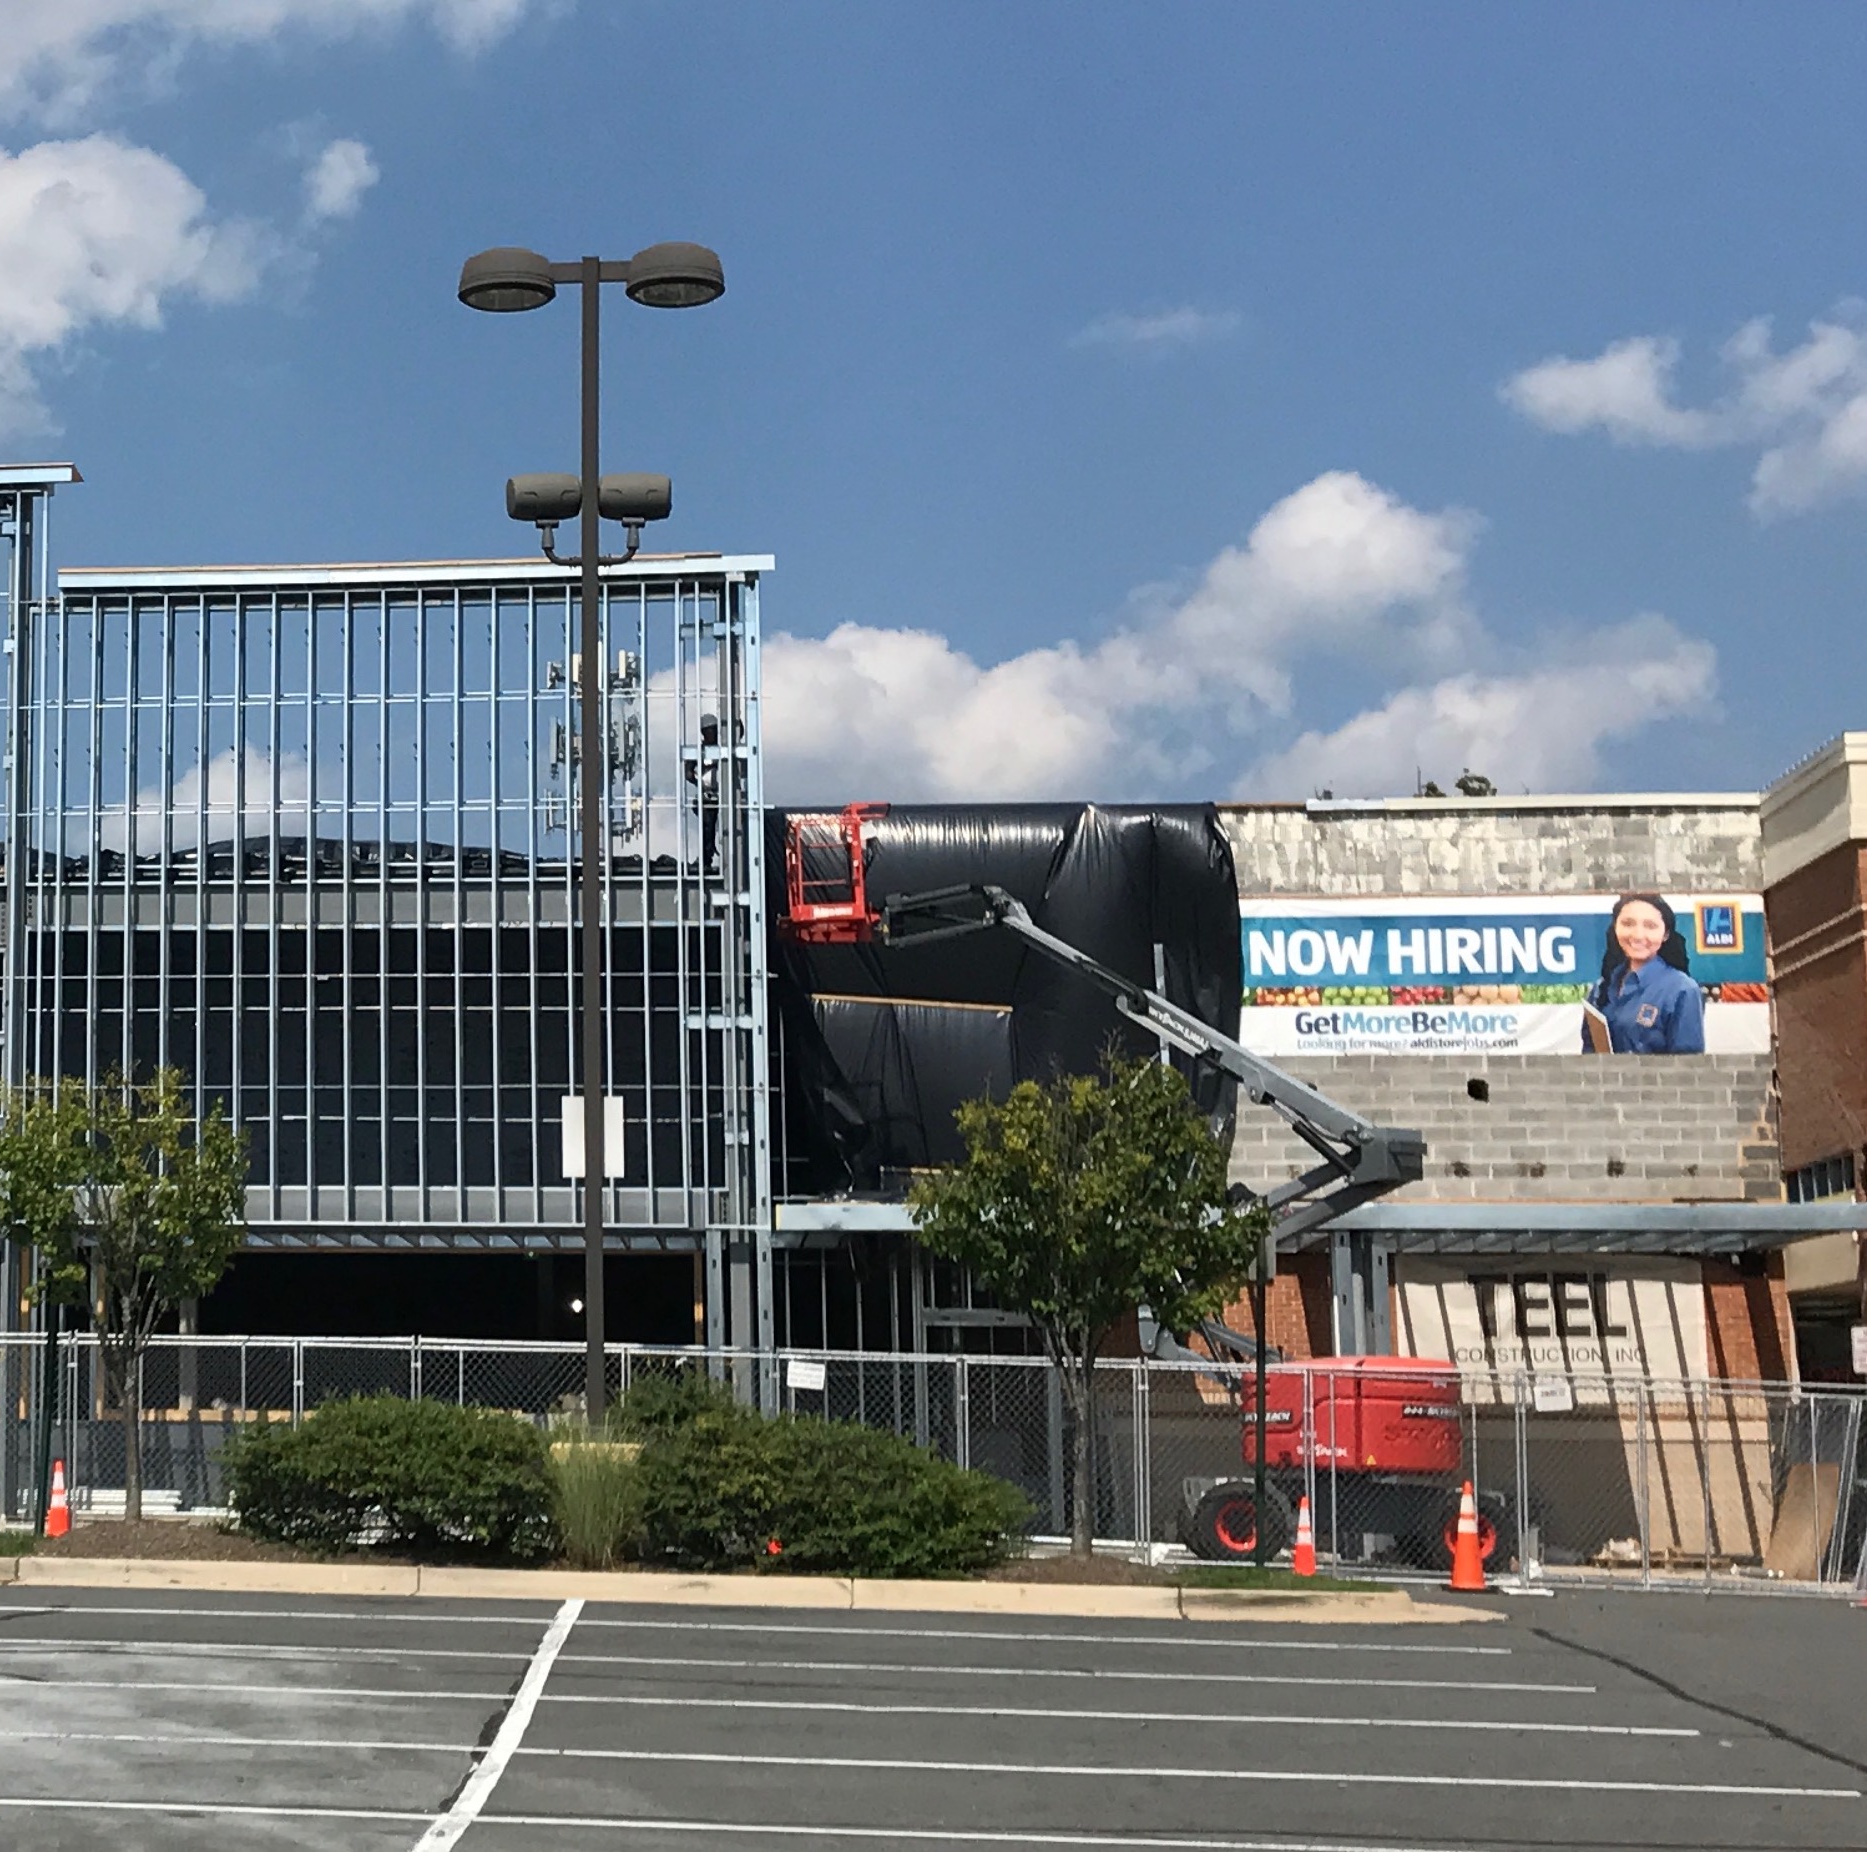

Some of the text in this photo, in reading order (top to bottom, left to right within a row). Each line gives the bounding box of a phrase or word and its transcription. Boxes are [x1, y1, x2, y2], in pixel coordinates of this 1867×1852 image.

[1706, 933, 1733, 945] ALDI
[1249, 927, 1576, 976] NOW HIRING
[1297, 1037, 1346, 1050] Looking
[1349, 1037, 1366, 1048] for
[1467, 1273, 1627, 1337] TEEL
[1457, 1346, 1605, 1363] CONSTRUCION
